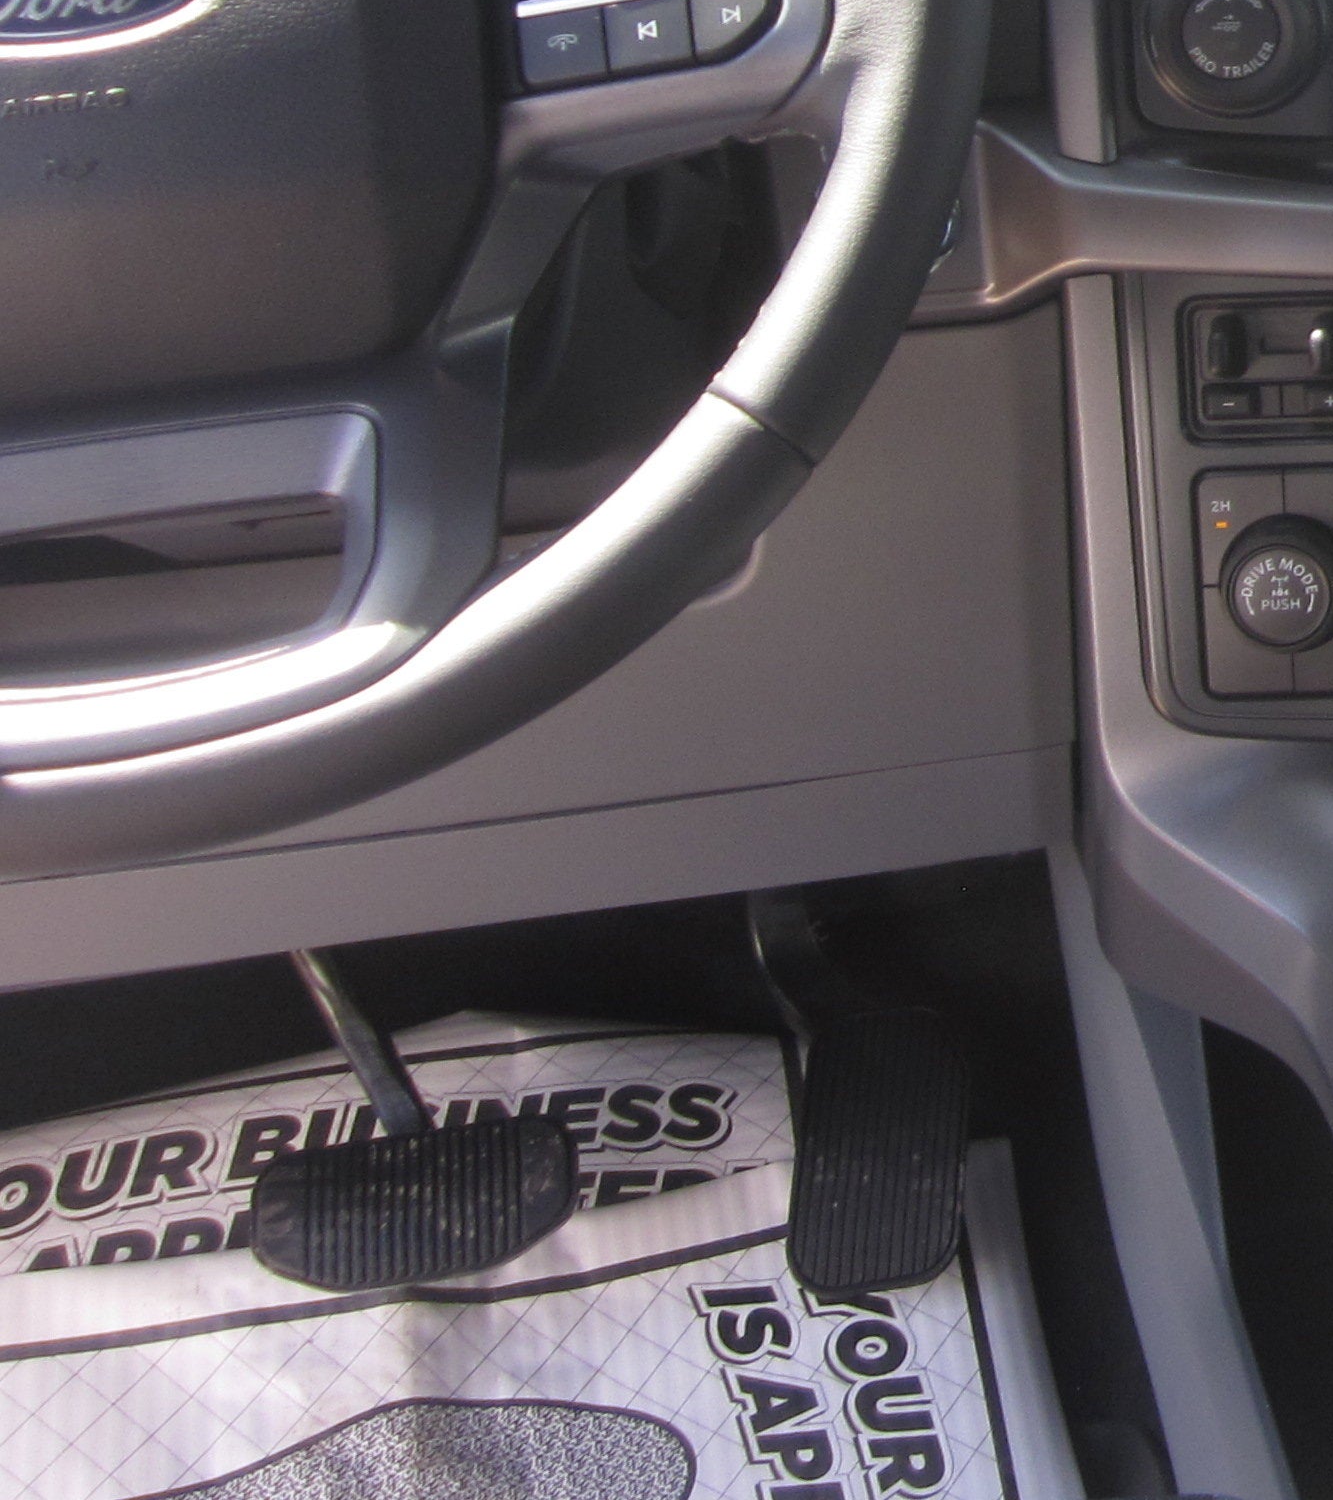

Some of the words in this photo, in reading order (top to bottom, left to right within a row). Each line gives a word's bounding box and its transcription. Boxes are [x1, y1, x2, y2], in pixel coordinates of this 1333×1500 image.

[1188, 46, 1217, 73] PRO
[1222, 41, 1276, 78] TRAILER
[1210, 500, 1231, 513] 2H
[1241, 558, 1275, 597] DRIVE
[1279, 557, 1319, 594] MODE
[1261, 599, 1300, 611] PUSH
[226, 1082, 724, 1182] BUESS
[701, 1285, 793, 1354] IS
